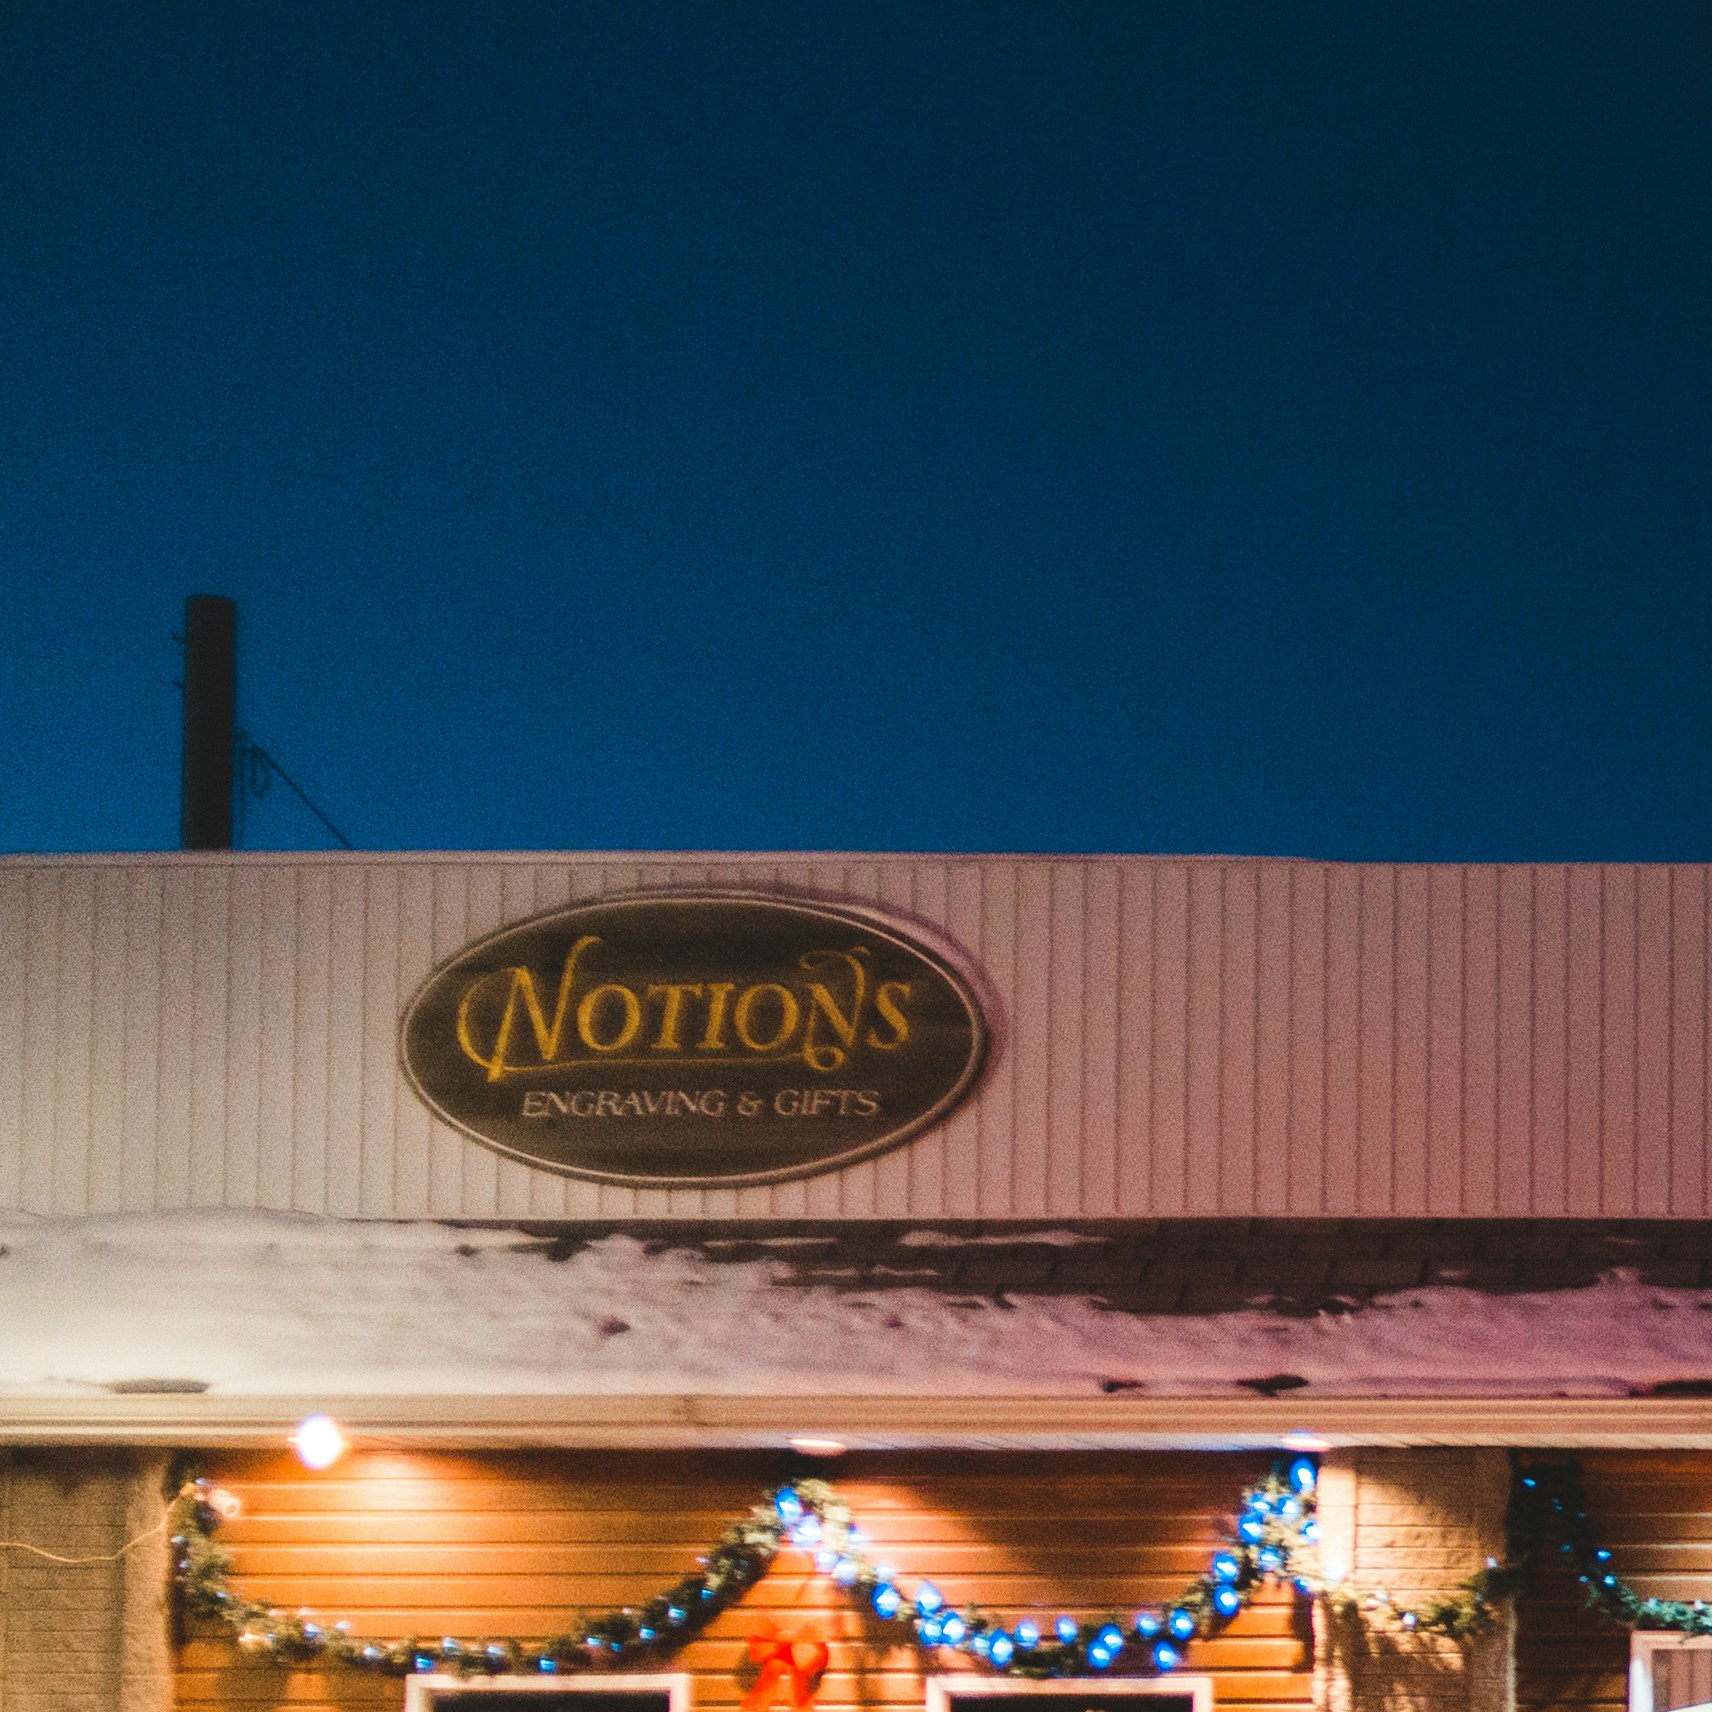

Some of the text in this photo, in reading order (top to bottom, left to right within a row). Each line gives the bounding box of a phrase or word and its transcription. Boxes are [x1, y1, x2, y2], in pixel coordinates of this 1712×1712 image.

[456, 935, 912, 1082] NOTIONS
[521, 1089, 882, 1118] ENGRAVING & GIFTS
